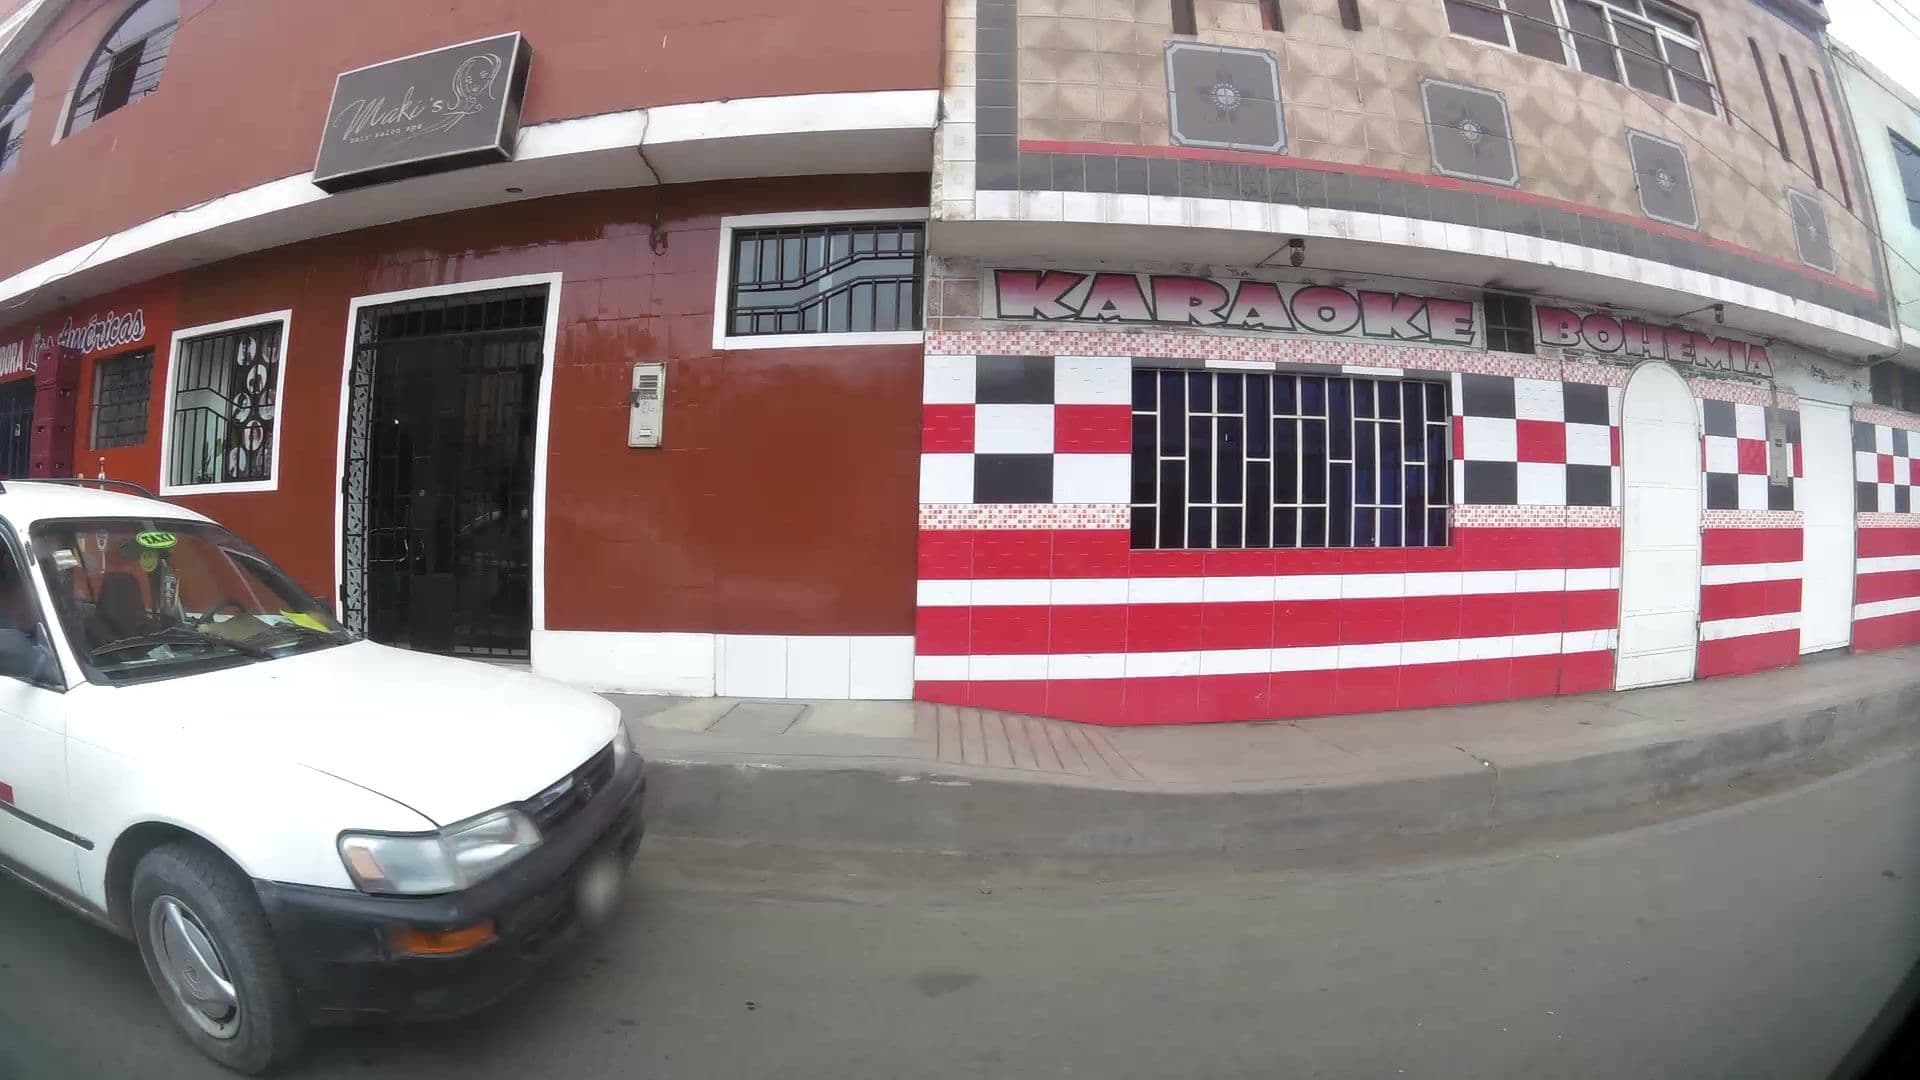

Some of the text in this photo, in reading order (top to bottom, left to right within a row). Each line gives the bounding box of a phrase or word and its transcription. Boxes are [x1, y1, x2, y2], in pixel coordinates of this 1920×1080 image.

[57, 308, 146, 354] Américas
[993, 268, 1476, 345] KARAOKE
[1535, 305, 1776, 378] BOHEMIA
[141, 534, 174, 544] TAXI
